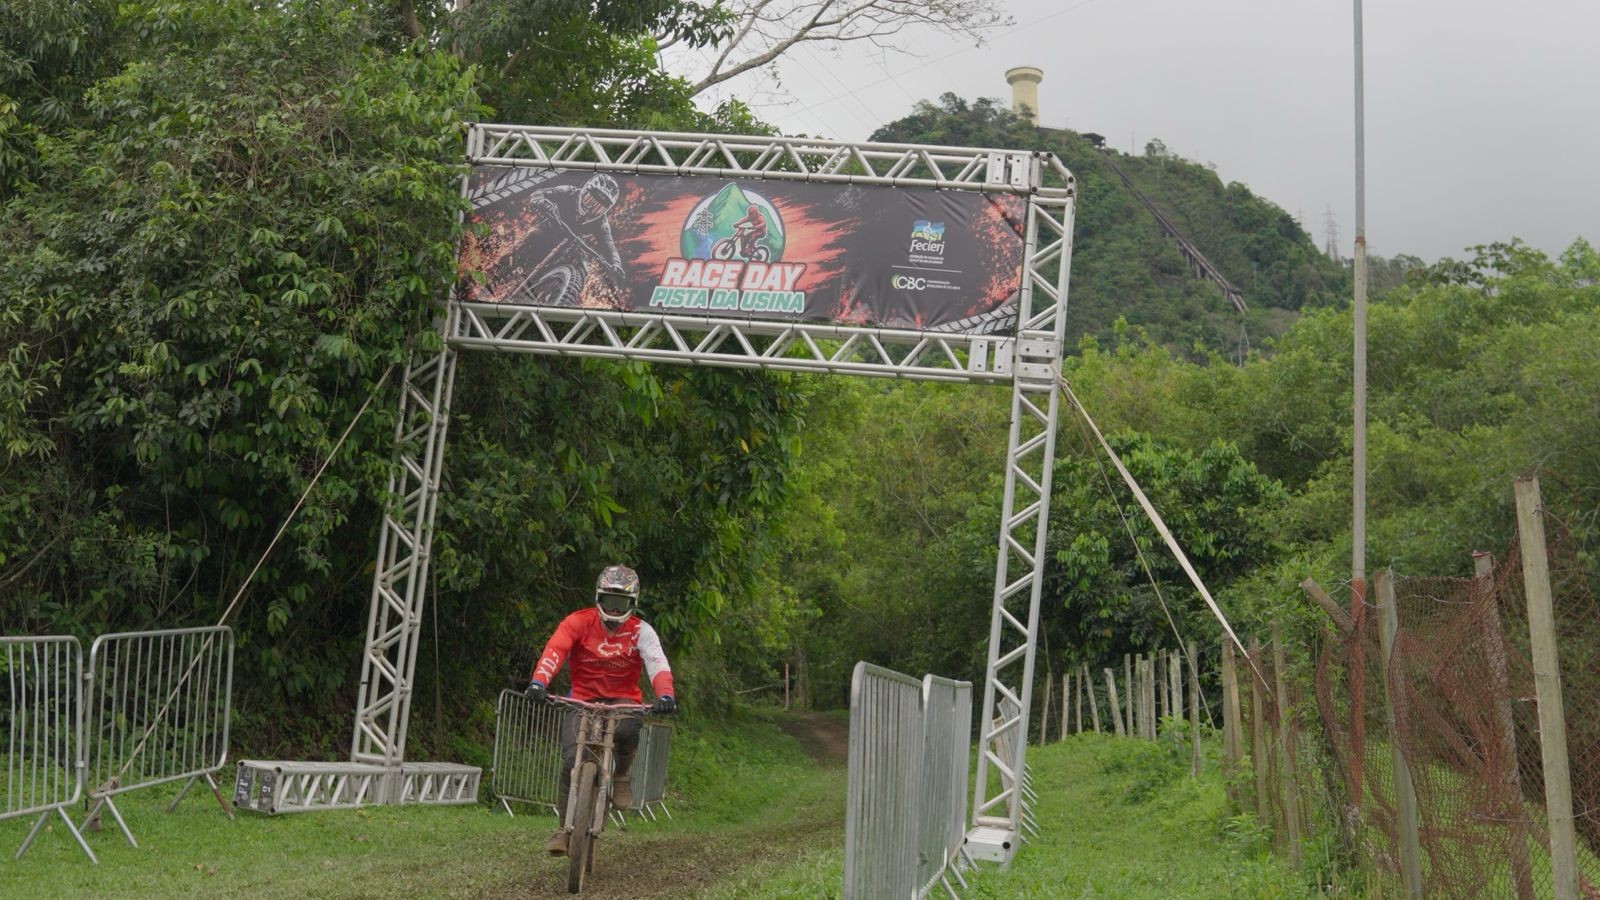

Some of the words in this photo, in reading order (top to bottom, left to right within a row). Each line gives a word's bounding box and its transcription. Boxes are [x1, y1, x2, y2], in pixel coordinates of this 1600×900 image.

[909, 239, 946, 255] Fecierj
[661, 259, 743, 289] RACE
[741, 262, 806, 291] DAY
[896, 275, 927, 291] CBC
[650, 286, 709, 309] PISTA
[709, 288, 739, 310] DA
[740, 290, 805, 313] USINA
